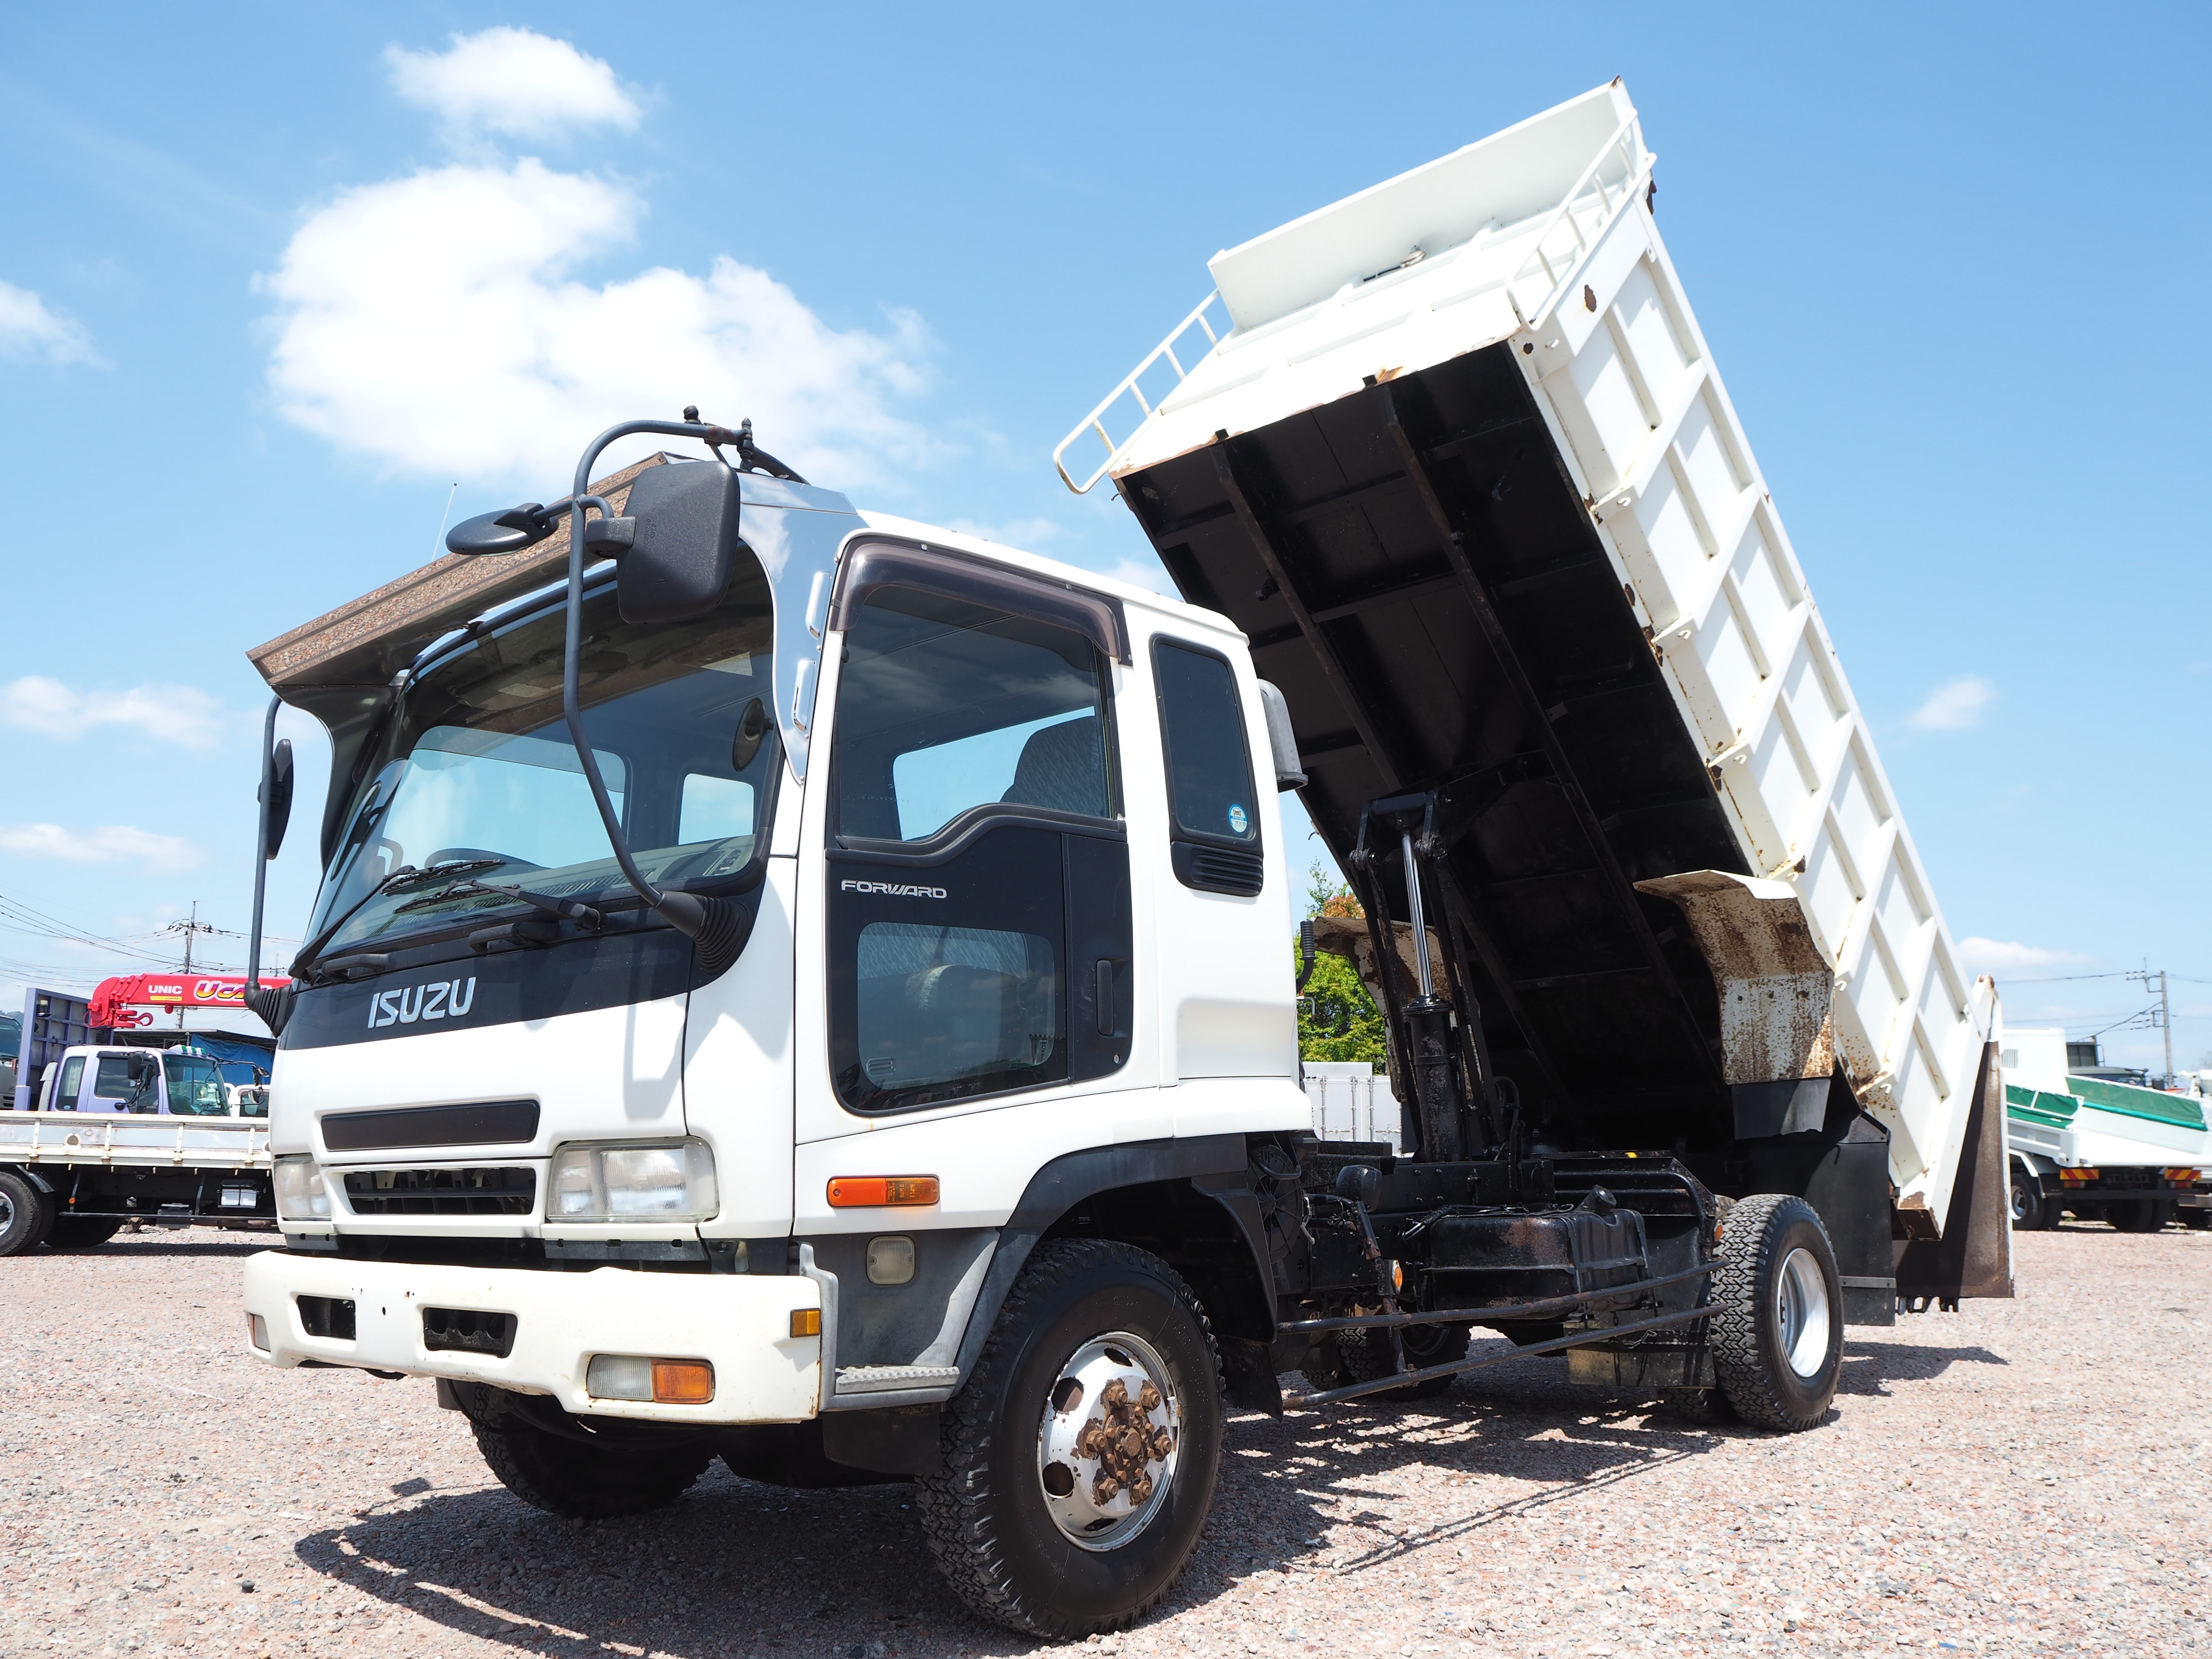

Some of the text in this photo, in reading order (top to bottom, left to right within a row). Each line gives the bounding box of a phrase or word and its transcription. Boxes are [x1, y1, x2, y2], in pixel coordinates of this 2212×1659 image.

[841, 880, 948, 899] FORWARD
[148, 985, 183, 995] UNIC
[367, 976, 476, 1029] ISUZU
